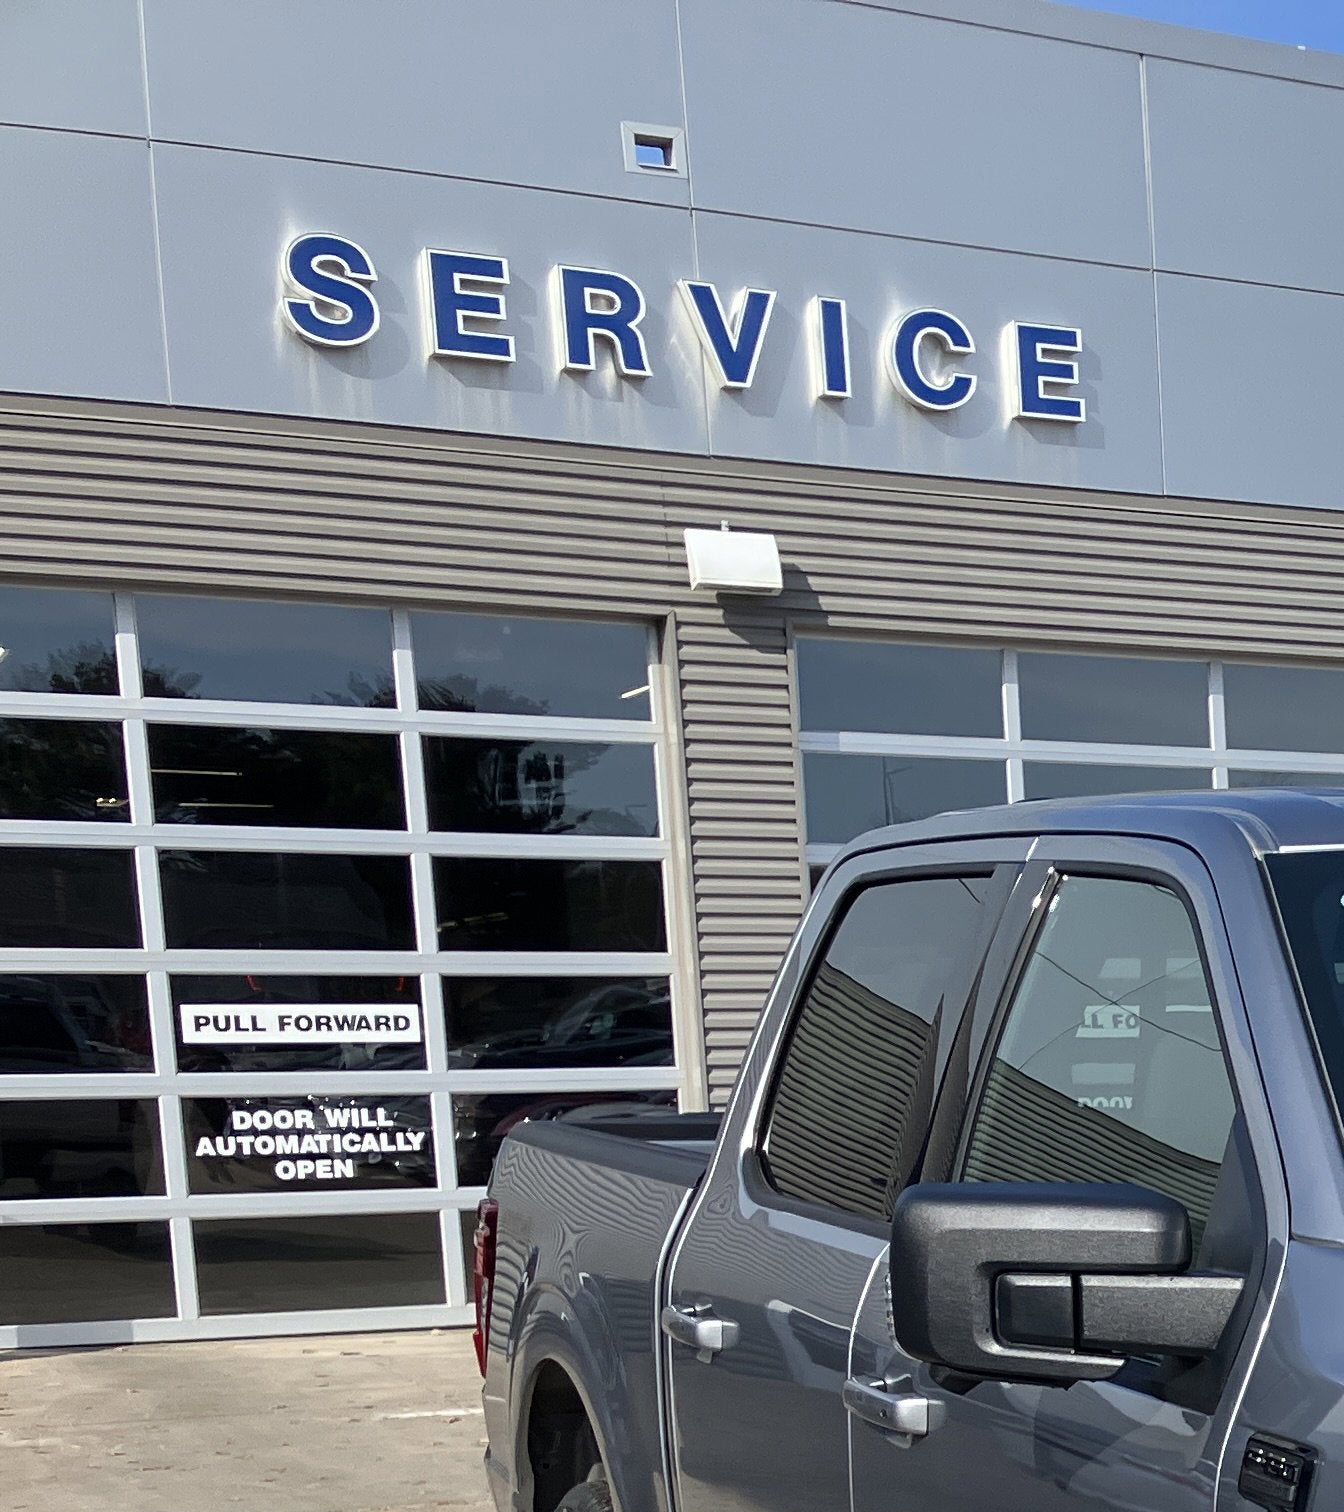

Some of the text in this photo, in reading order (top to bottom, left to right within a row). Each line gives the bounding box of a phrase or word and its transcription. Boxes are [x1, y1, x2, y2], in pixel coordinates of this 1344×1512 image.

[280, 231, 1087, 424] SERVICE
[193, 1014, 411, 1032] PULL FORWARD
[231, 1107, 394, 1131] DOOR WILL
[195, 1131, 426, 1157] AUTOMATICALLY
[274, 1158, 355, 1181] OPEN
